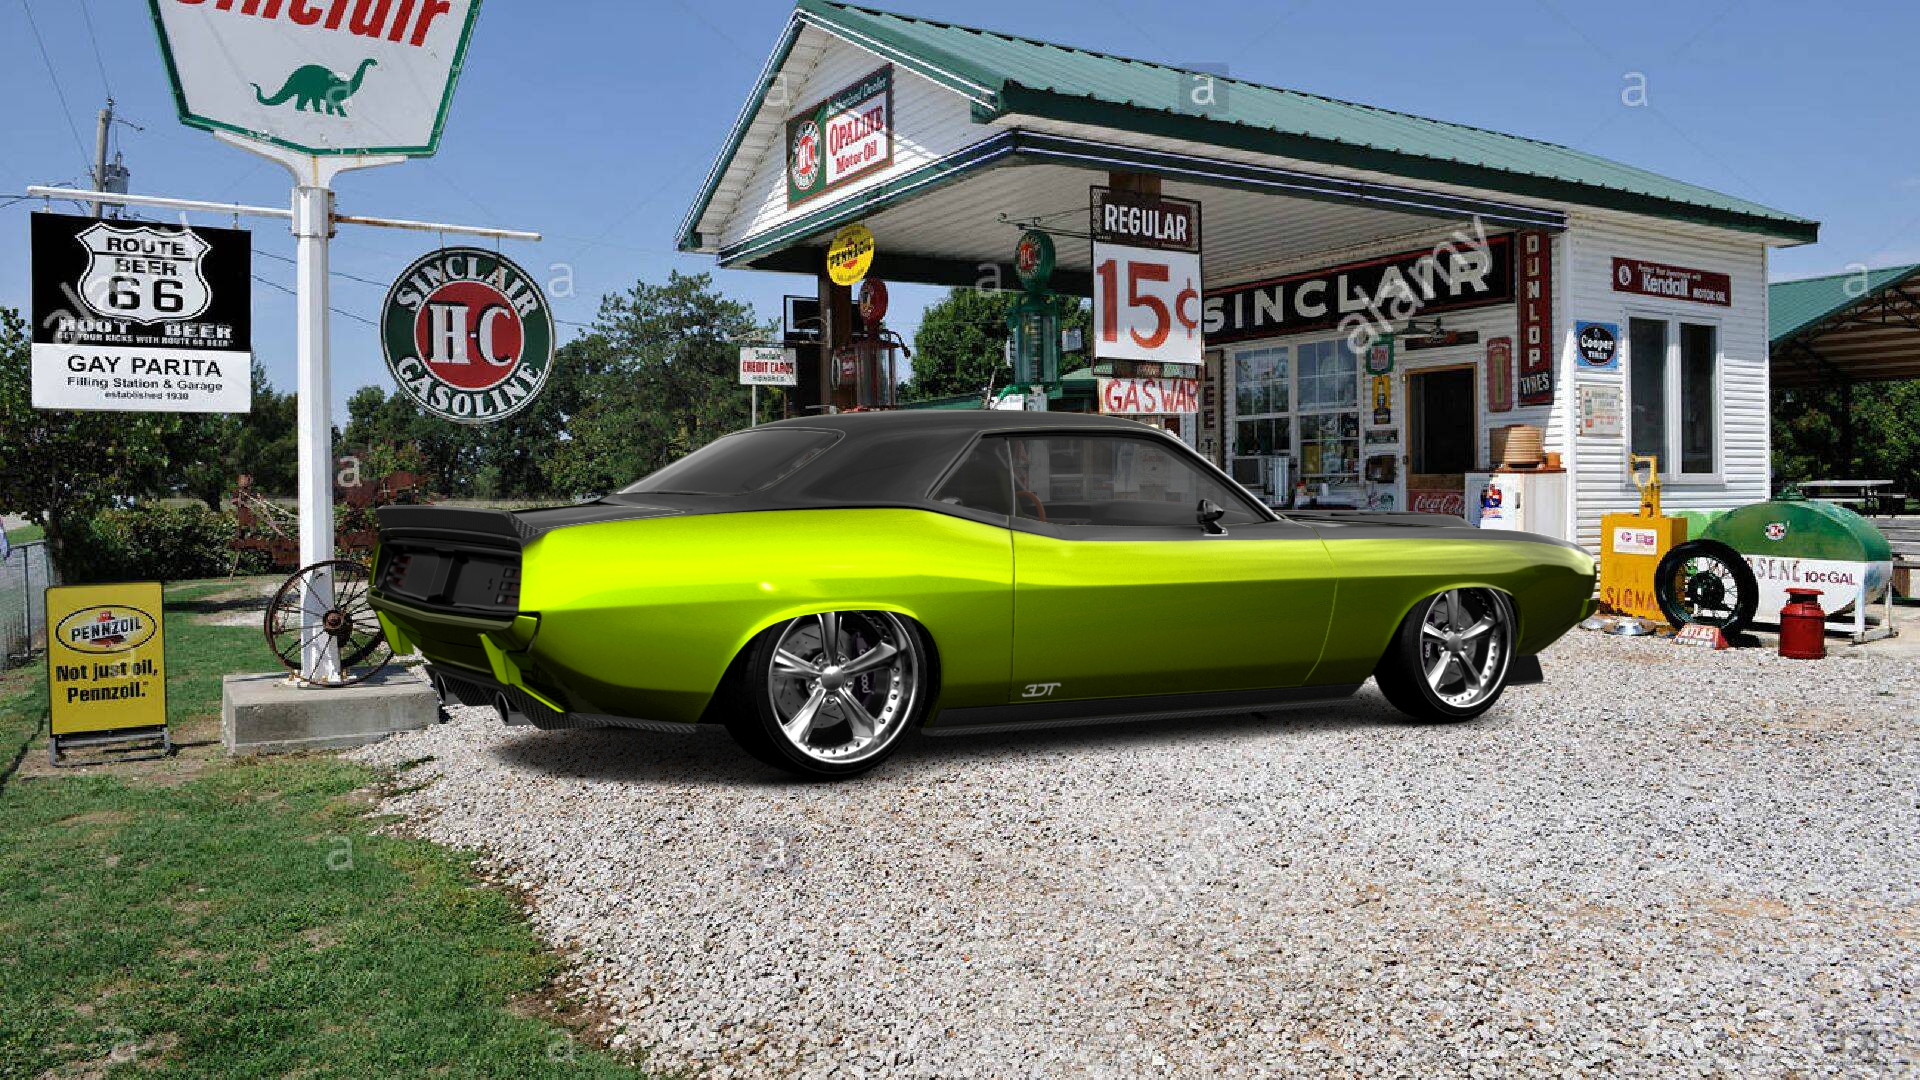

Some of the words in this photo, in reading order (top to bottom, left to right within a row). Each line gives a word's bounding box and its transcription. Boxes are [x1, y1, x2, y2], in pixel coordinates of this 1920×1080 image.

[175, 0, 450, 47] clair
[829, 105, 884, 156] OPALINE
[836, 152, 863, 174] Motor
[864, 140, 878, 161] Oil
[1105, 203, 1187, 241] REGULAR
[107, 237, 186, 255] ROUTE
[115, 258, 177, 275] BEER
[108, 276, 184, 312] 66
[397, 257, 539, 318] SINCLAIR
[1203, 250, 1490, 333] SINCLAIR
[1643, 272, 1688, 296] Kendall
[1097, 259, 1199, 349] 15¢
[1526, 235, 1541, 367] DUNLOP
[164, 321, 233, 339] BEER
[1581, 334, 1613, 352] Cooper
[67, 355, 121, 373] GAY
[132, 357, 222, 377] PARITA
[742, 361, 768, 373] CREDIT
[770, 361, 794, 374] CARDS
[67, 377, 108, 389] Filling
[113, 377, 159, 389] Station
[163, 379, 173, 389] &
[177, 380, 223, 393] Garage
[105, 390, 163, 400] established
[397, 356, 542, 417] GASOLINE
[1105, 378, 1156, 412] GAS
[1159, 378, 1199, 412] WAR
[1828, 571, 1856, 586] GAL
[71, 617, 142, 642] PENNZOIL
[56, 665, 88, 682] Not
[93, 662, 127, 681] just
[132, 659, 157, 676] oil,
